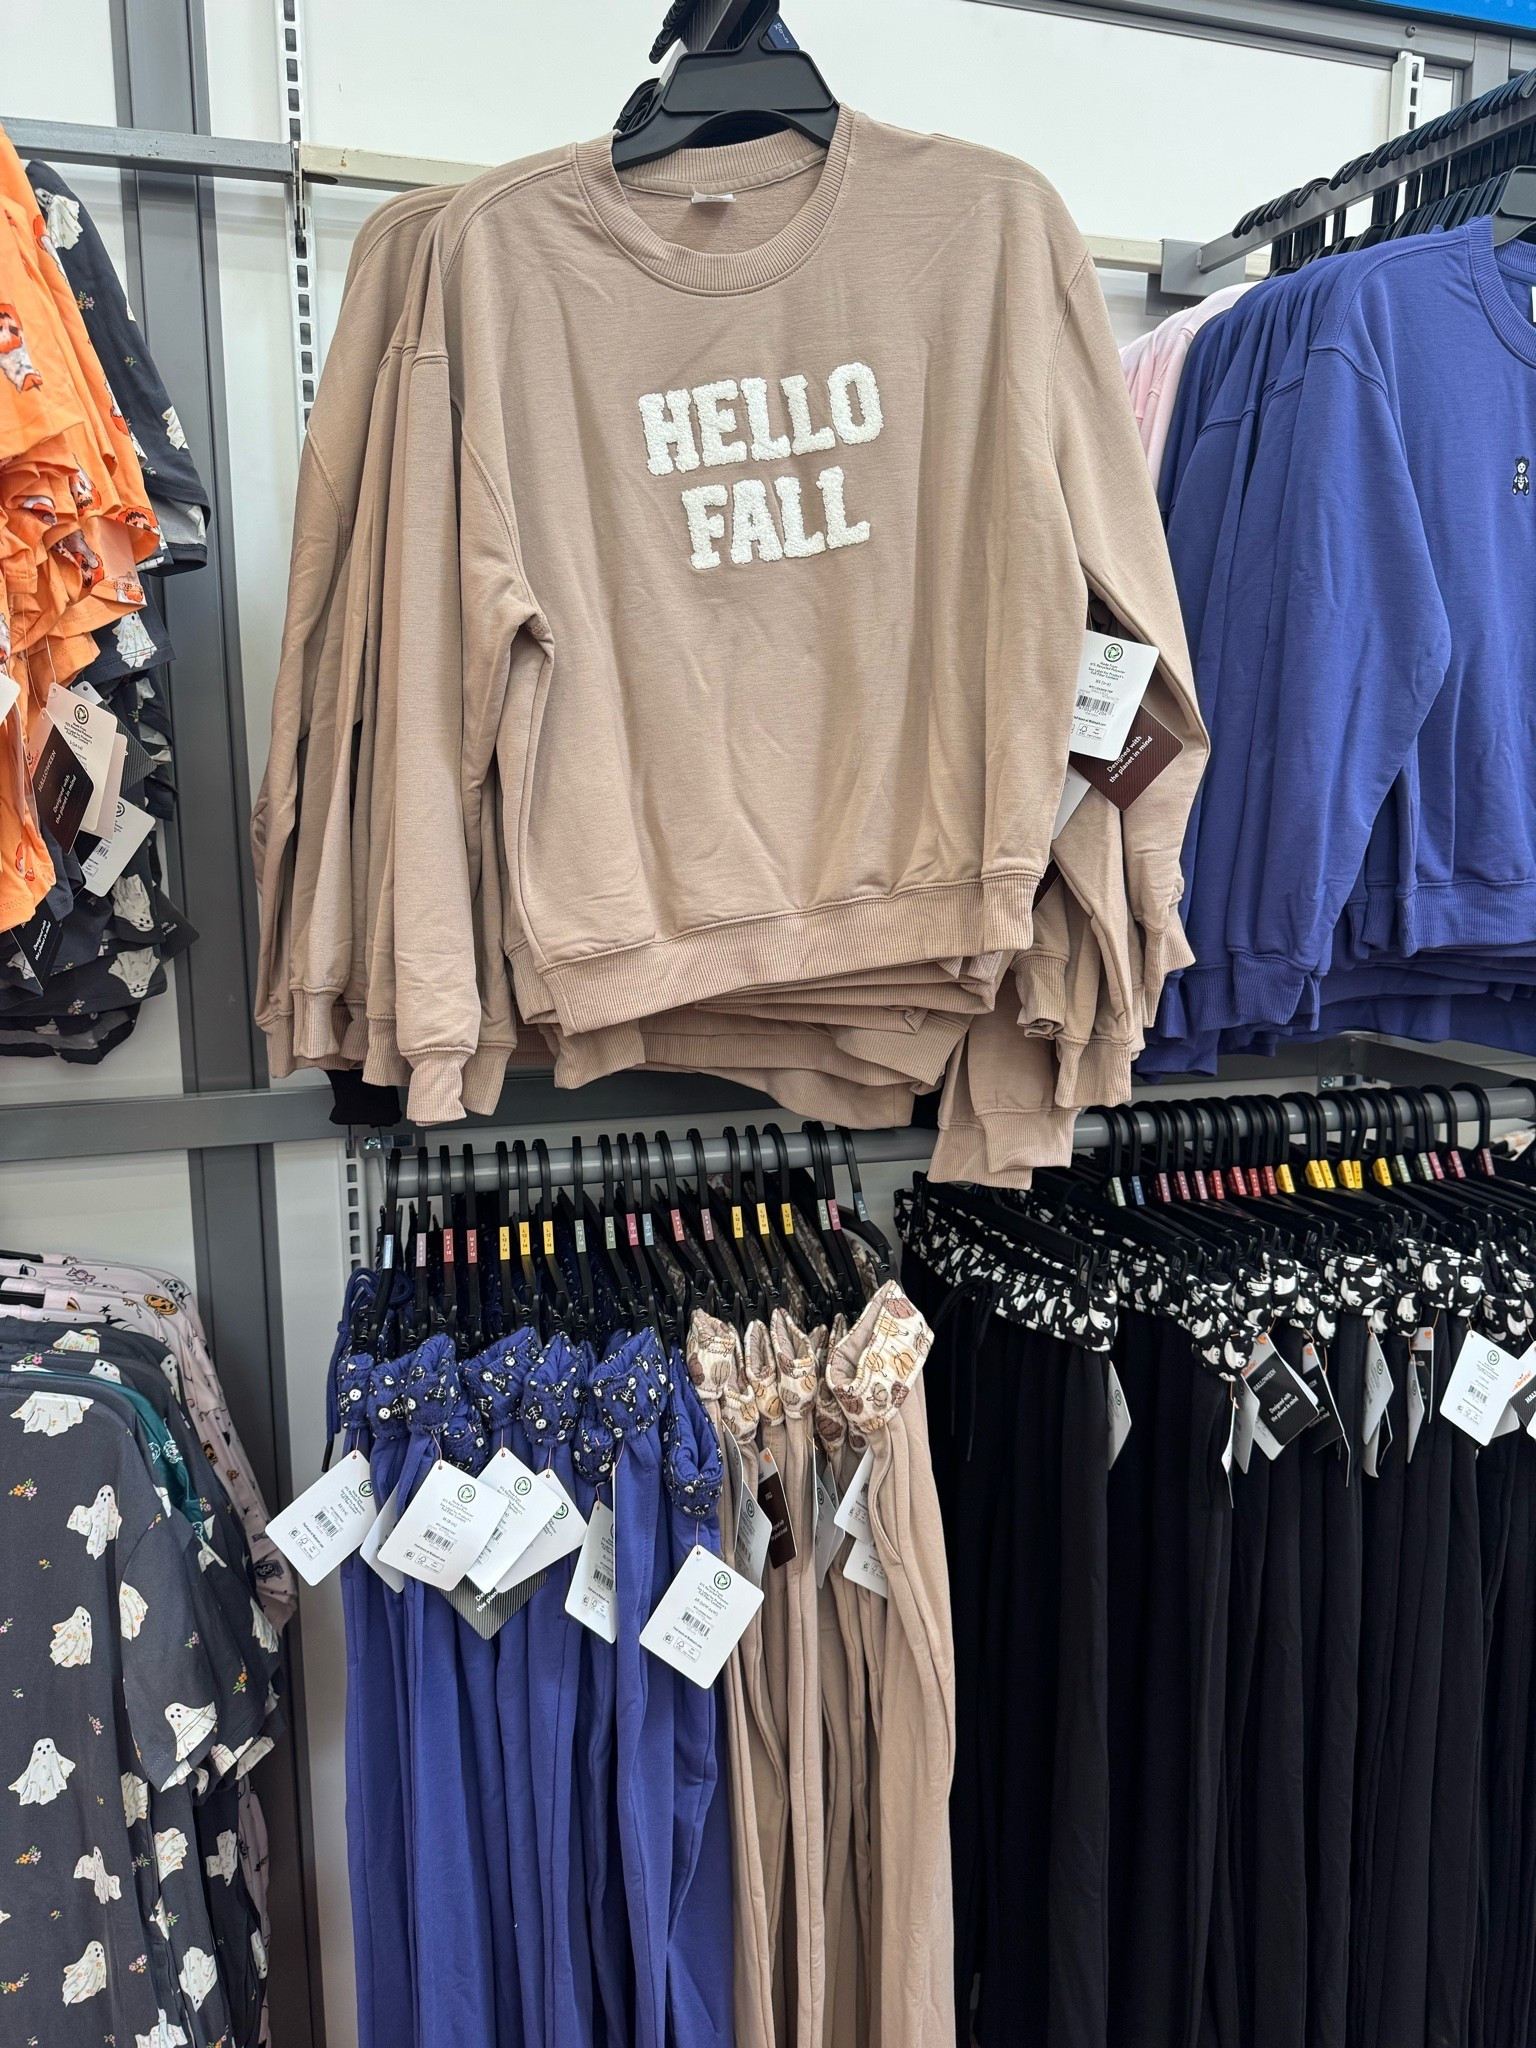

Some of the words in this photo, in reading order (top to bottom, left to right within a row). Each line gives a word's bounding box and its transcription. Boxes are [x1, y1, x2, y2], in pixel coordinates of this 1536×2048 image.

[638, 362, 884, 475] HELLO
[681, 466, 871, 570] FALL
[38, 750, 55, 791] HALLOWEEN
[1106, 747, 1131, 773] Designed
[1129, 736, 1142, 748] with
[1109, 773, 1119, 782] the
[1118, 756, 1134, 775] planet
[1138, 735, 1152, 751] mind
[52, 786, 64, 813] Designed
[59, 796, 68, 815] planet
[68, 774, 76, 790] mind
[1276, 1406, 1287, 1418] planet
[1289, 1395, 1298, 1405] mind
[476, 1602, 486, 1612] the
